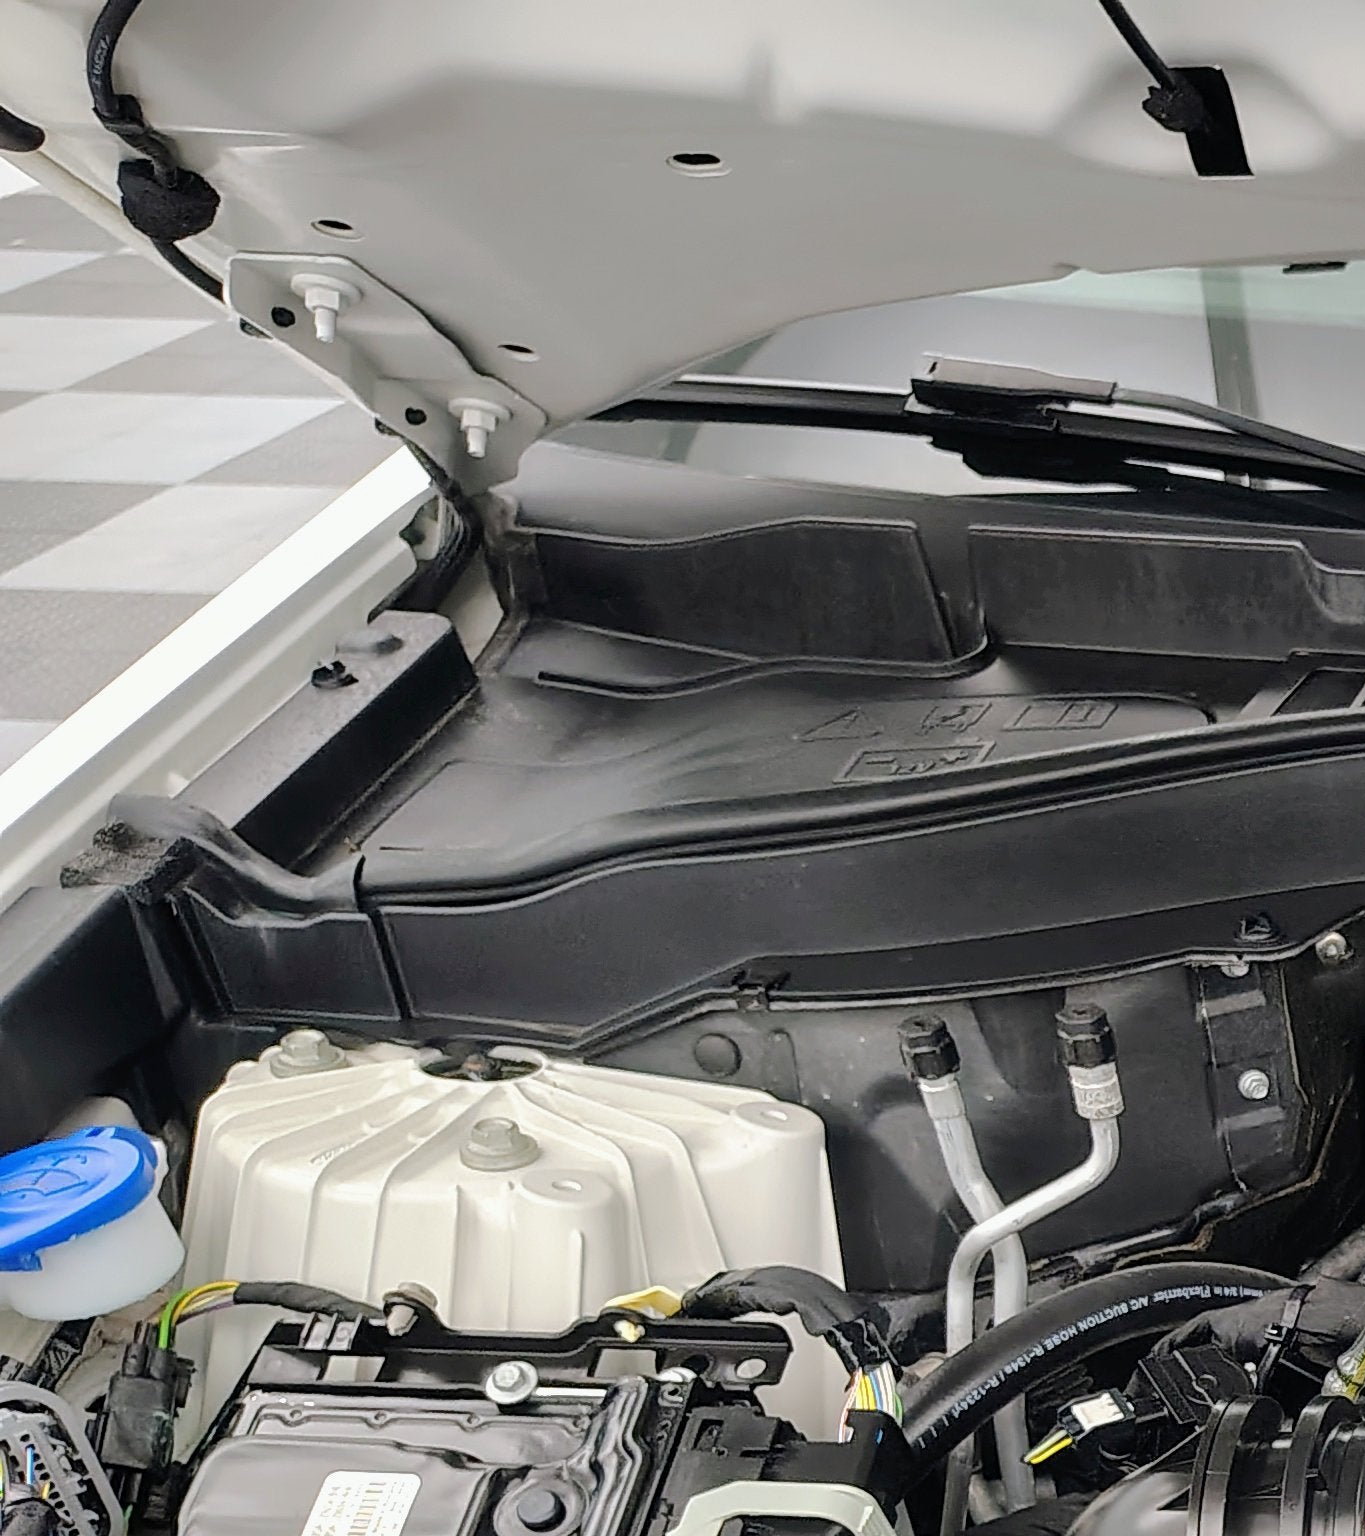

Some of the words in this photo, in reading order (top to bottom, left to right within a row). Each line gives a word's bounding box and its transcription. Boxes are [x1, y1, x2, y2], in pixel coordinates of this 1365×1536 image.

[1129, 1295, 1149, 1310] A/C
[1153, 1284, 1211, 1303] Flexbarrier
[1077, 1302, 1129, 1332] SUCTION
[1043, 1324, 1079, 1350] HOSE
[1003, 1344, 1045, 1375] R-134a
[951, 1375, 1001, 1419] R-1234yf
